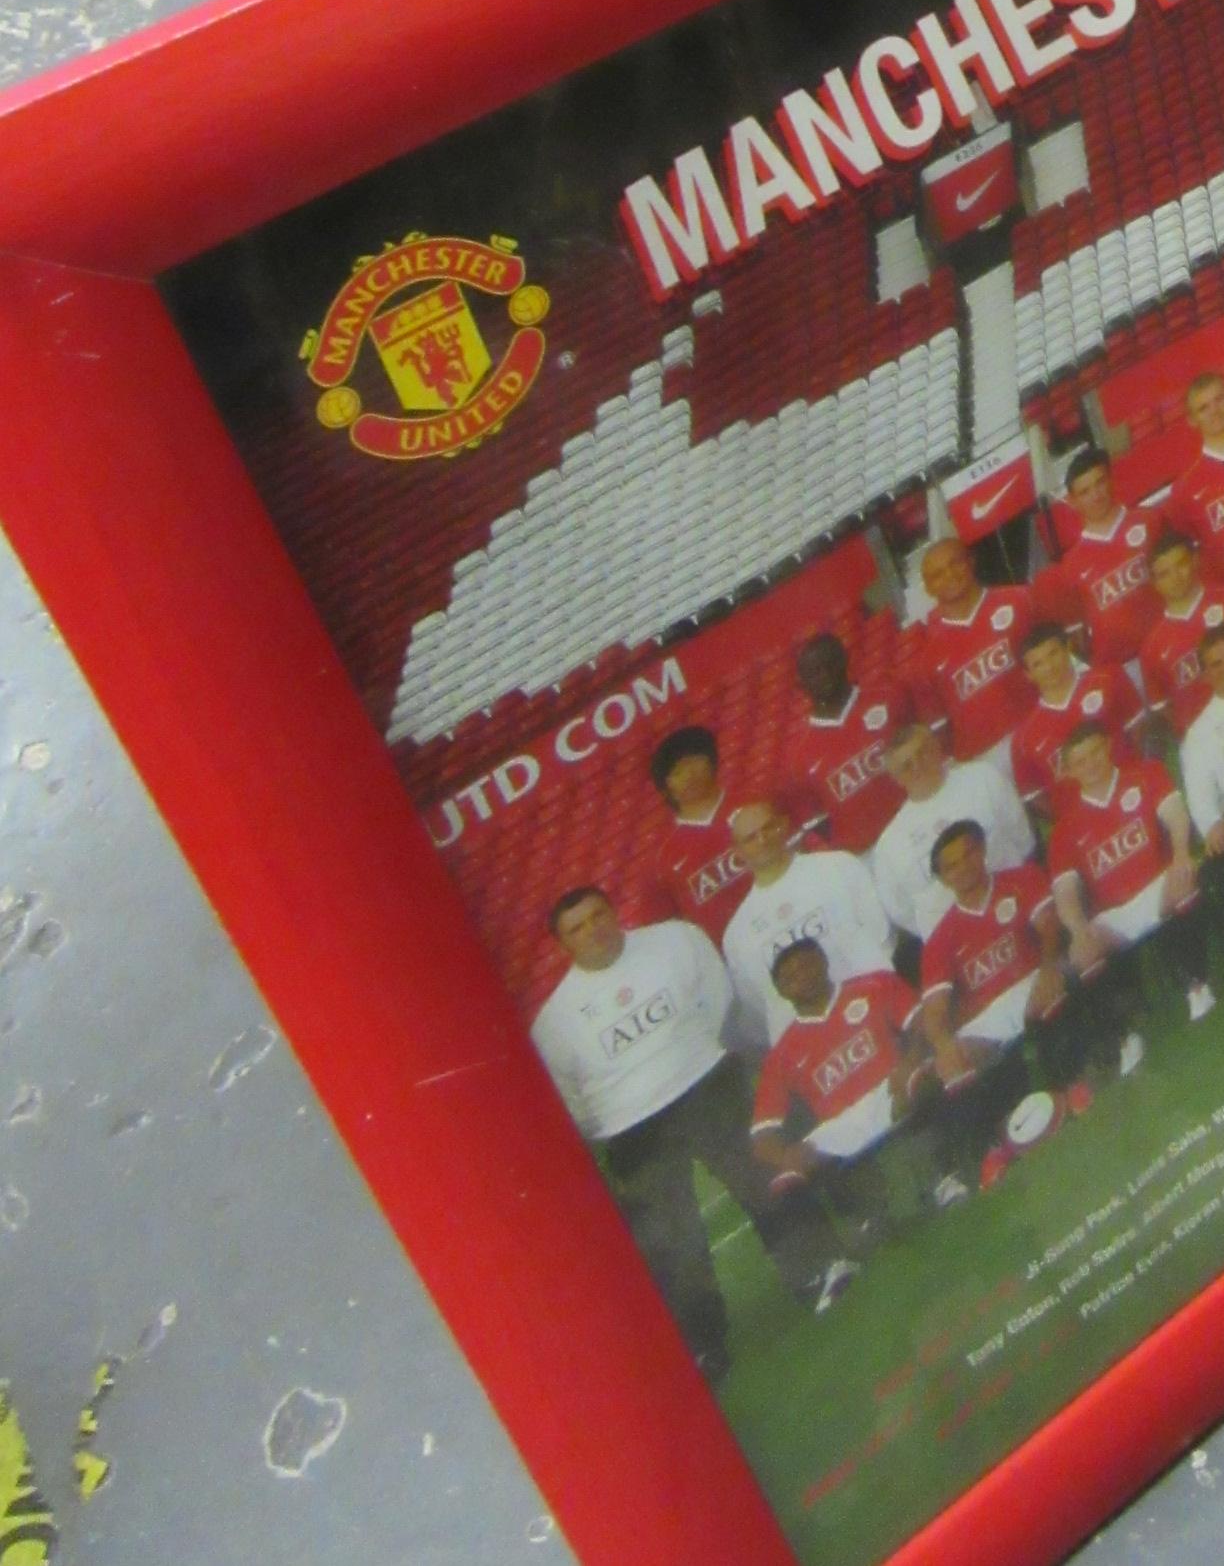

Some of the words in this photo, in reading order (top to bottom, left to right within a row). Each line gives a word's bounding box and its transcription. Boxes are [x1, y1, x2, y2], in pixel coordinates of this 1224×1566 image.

[324, 247, 507, 366] MANCHESTER
[400, 369, 524, 452] UNITED
[1096, 564, 1146, 604] AIG
[959, 646, 1010, 695] AIG
[555, 657, 688, 763] COM
[1096, 827, 1147, 874] AIG
[968, 937, 1015, 985] AIG
[608, 994, 674, 1054] AIG
[819, 1037, 876, 1088] AIG
